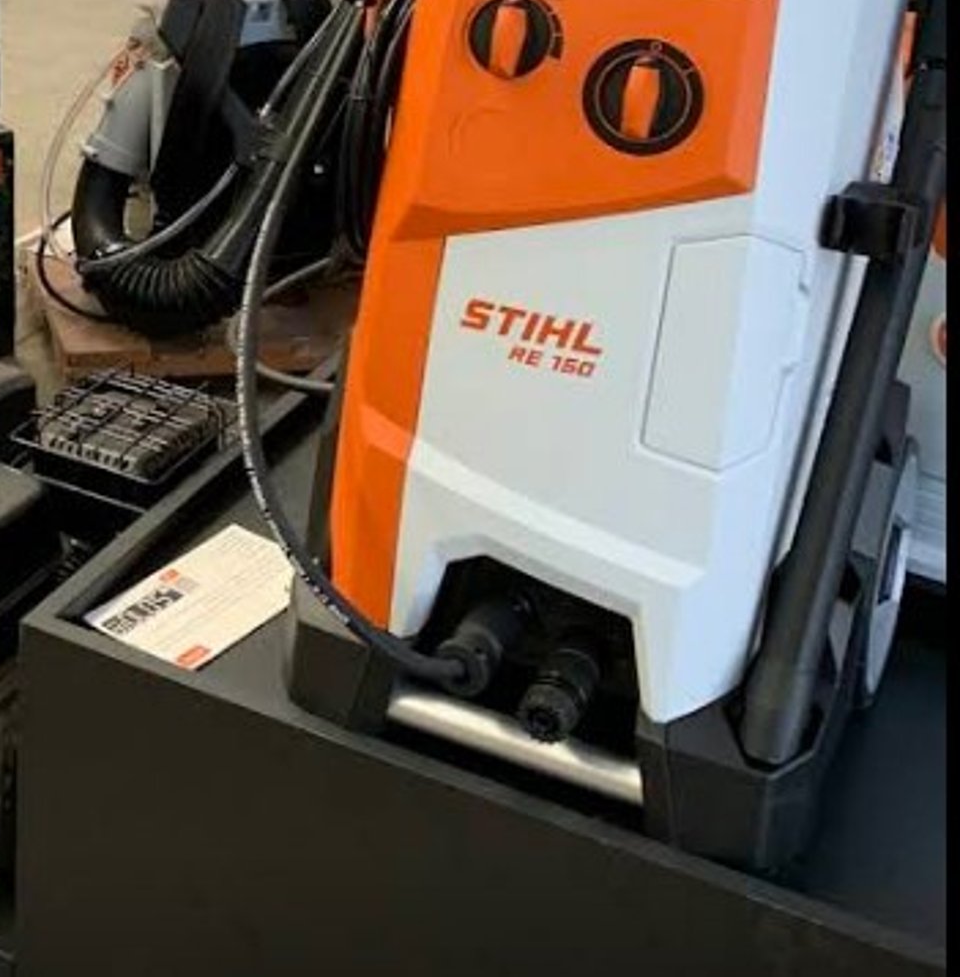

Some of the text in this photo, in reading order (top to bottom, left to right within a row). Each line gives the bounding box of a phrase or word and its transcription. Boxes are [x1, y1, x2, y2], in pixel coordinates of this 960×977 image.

[460, 298, 602, 356] STIHL
[508, 345, 596, 378] RE 150
